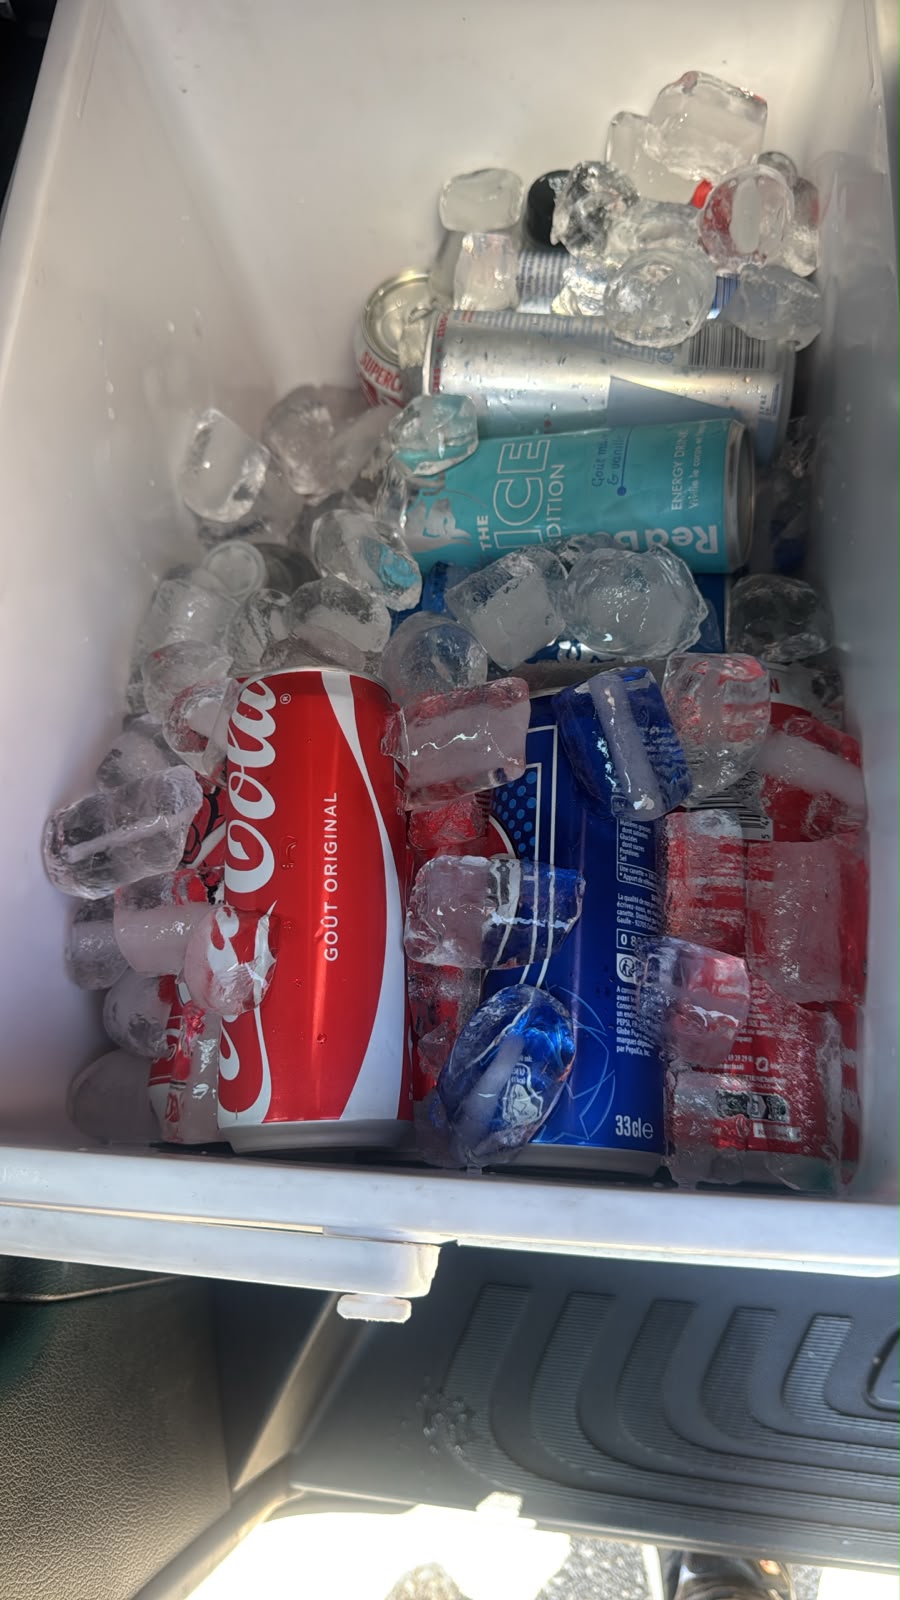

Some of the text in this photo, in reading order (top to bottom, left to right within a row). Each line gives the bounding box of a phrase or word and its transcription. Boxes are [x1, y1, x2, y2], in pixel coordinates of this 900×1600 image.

[360, 351, 403, 392] SUPERC
[493, 440, 551, 549] ICE
[607, 474, 619, 486] &
[671, 429, 689, 510] ENERGY DRINK
[546, 464, 566, 538] DITION
[476, 515, 492, 551] THE
[320, 792, 338, 962] GOÛT ORIGINAL
[620, 933, 628, 945] 0
